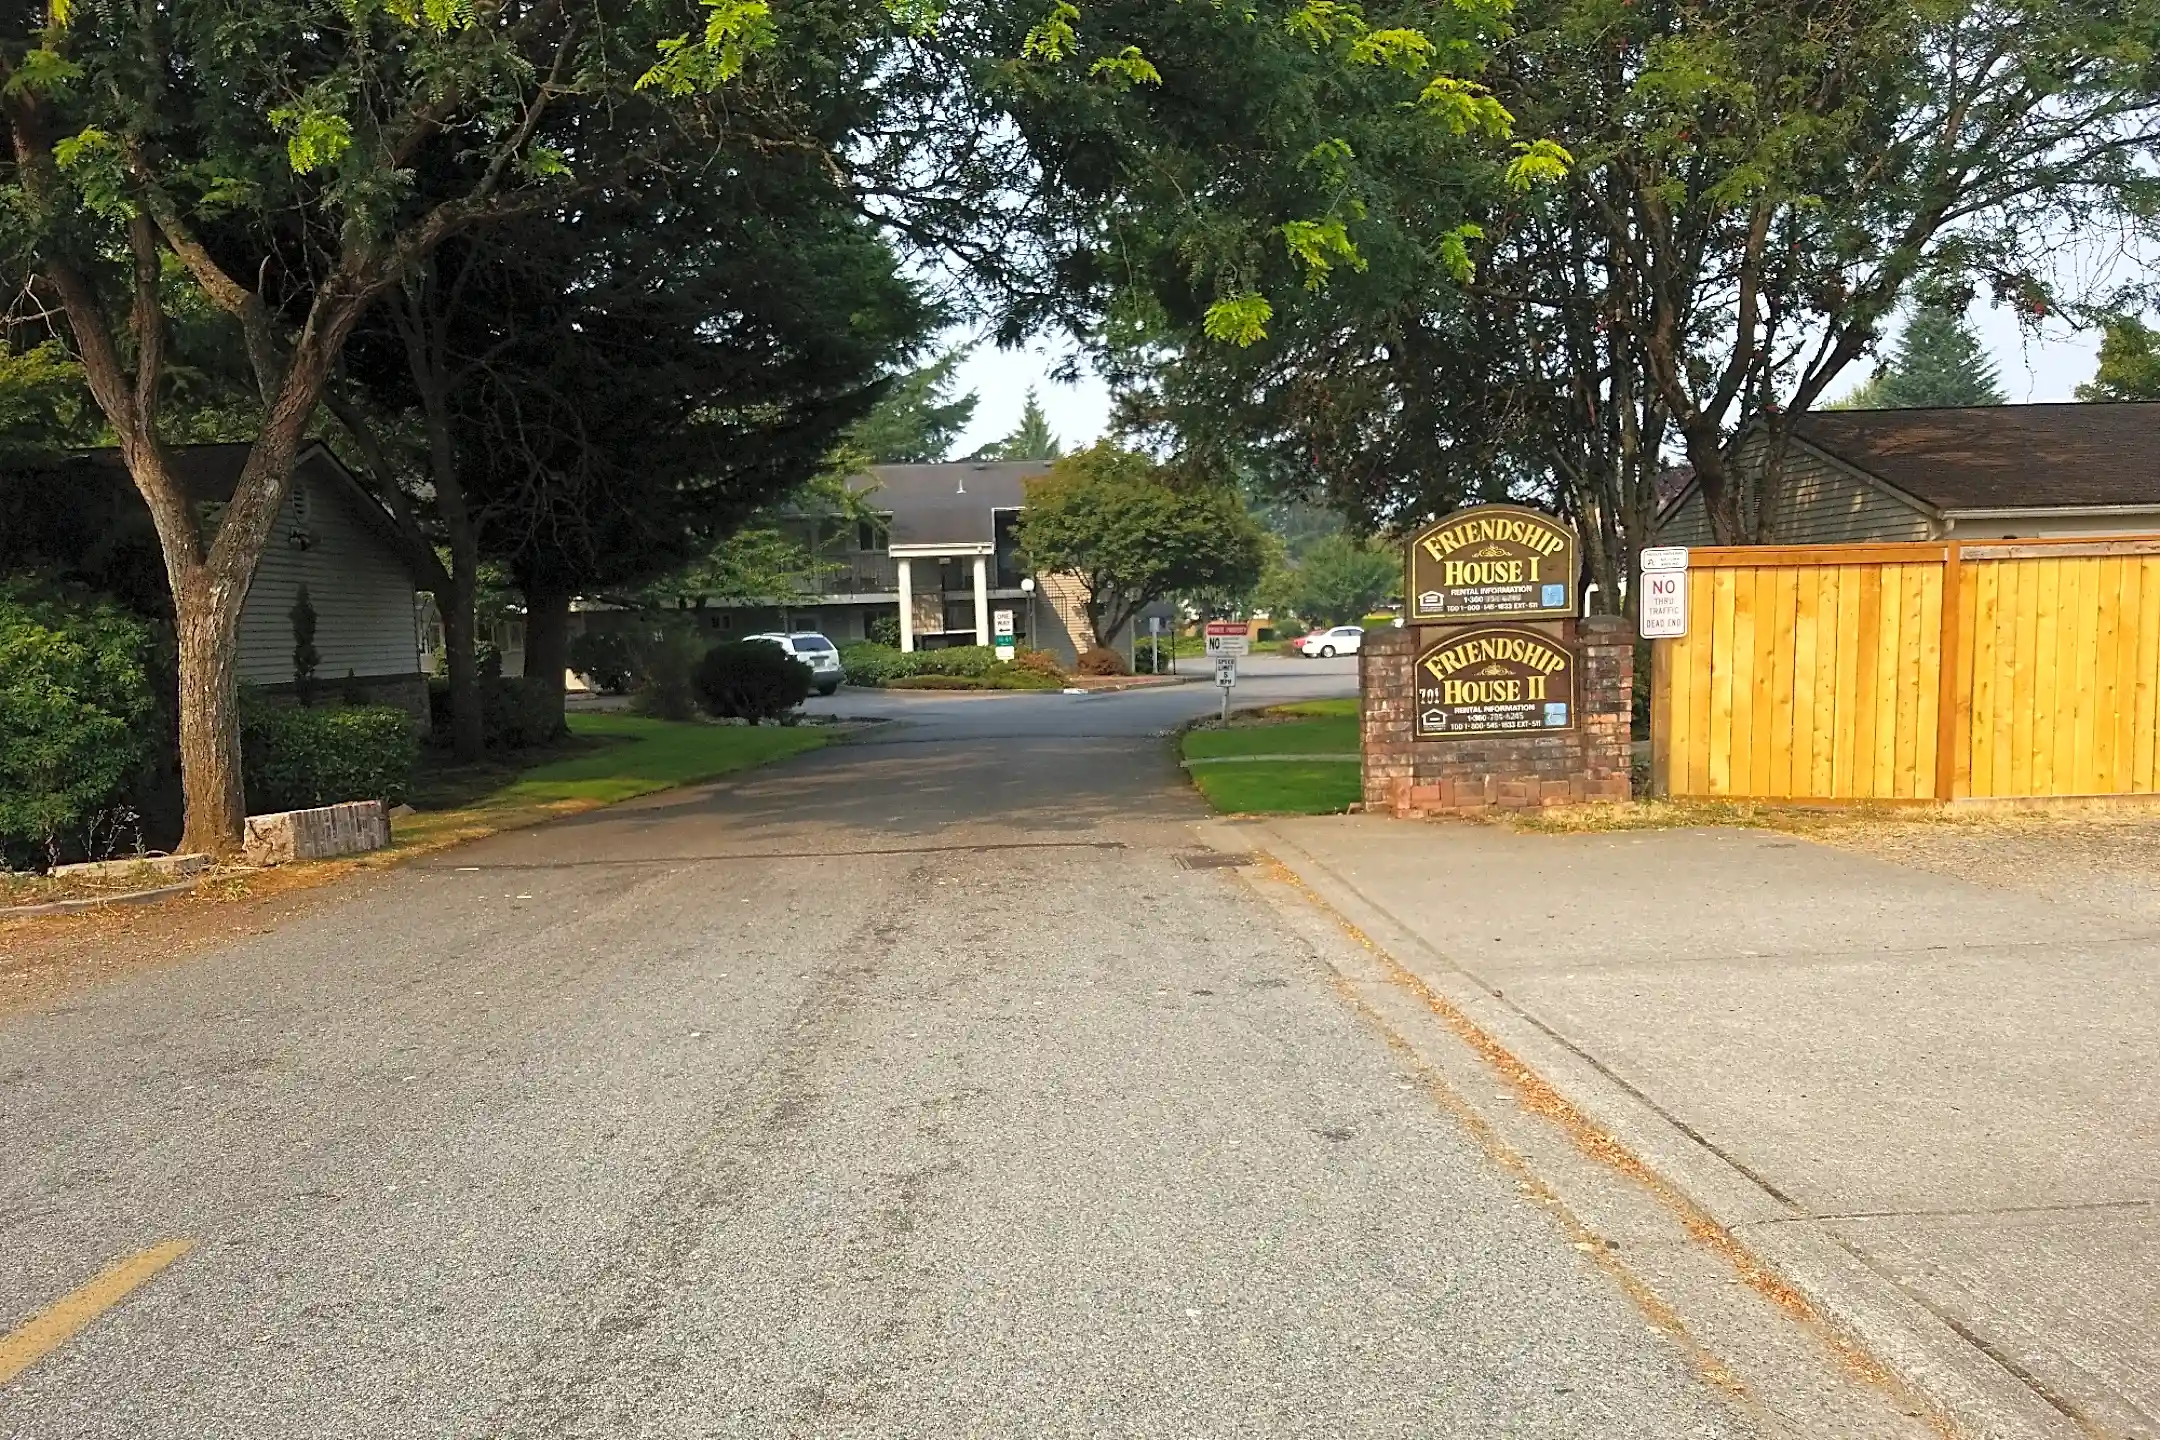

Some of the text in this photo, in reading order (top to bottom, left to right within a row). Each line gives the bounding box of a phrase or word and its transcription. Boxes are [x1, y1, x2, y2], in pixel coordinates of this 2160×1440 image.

[1422, 518, 1564, 562] FRIENDSHIP
[1443, 556, 1541, 586] HOUSE I
[1450, 584, 1533, 596] RENTAL INFORMATION
[1653, 580, 1676, 594] NO
[1654, 597, 1674, 606] THRU
[1649, 606, 1680, 616] TRAFFIC
[1646, 618, 1681, 629] DEAD END
[1209, 637, 1220, 650] NO
[1424, 638, 1565, 681] FRIENDSHIP
[1419, 688, 1440, 704] 701
[1443, 675, 1547, 705] HOUSE II
[1454, 703, 1536, 714] RENTAL INFORMATION
